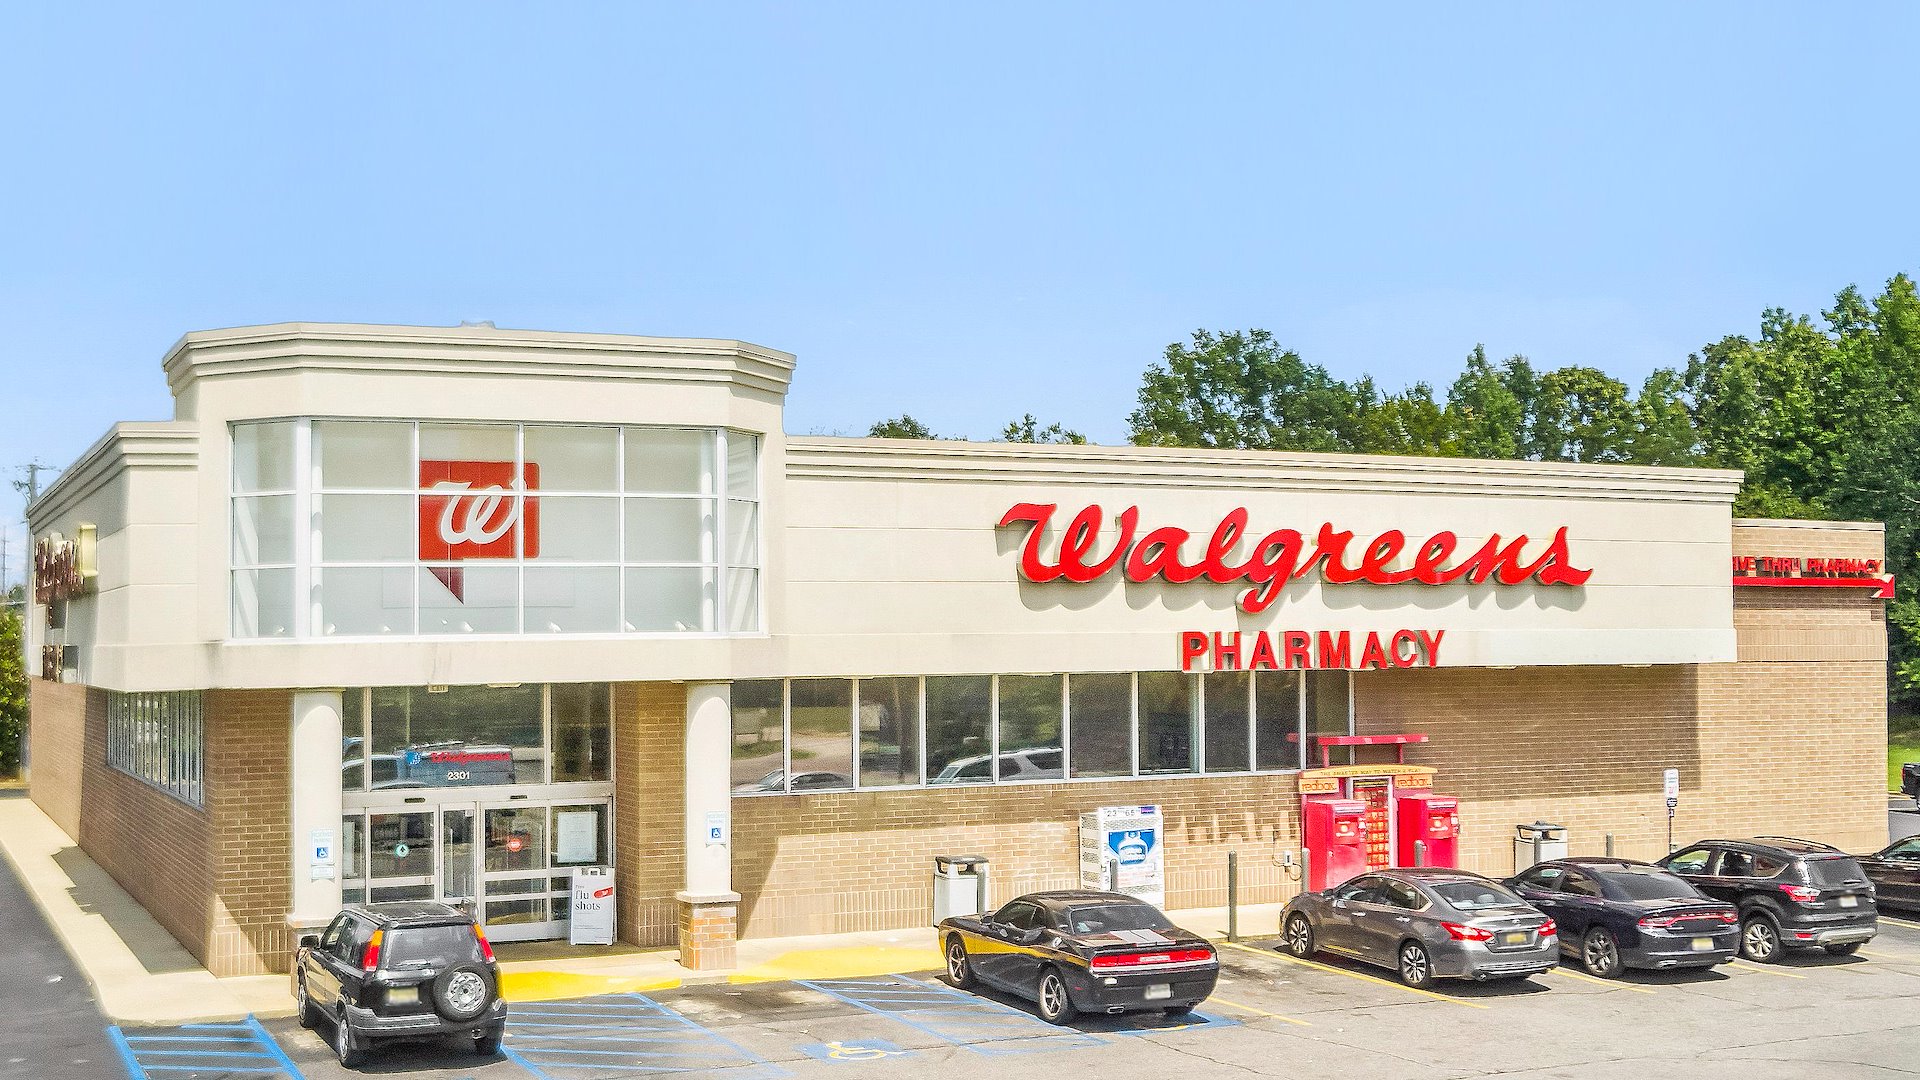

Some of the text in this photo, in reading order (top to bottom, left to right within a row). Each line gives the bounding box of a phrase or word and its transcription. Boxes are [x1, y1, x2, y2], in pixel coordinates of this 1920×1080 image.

[999, 503, 1594, 614] Walgreens
[1732, 556, 1883, 573] IVE THRU PHARMACY
[1182, 629, 1446, 670] PHARMACY
[447, 771, 471, 781] 2301
[575, 890, 589, 899] flu
[575, 901, 600, 910] shots
